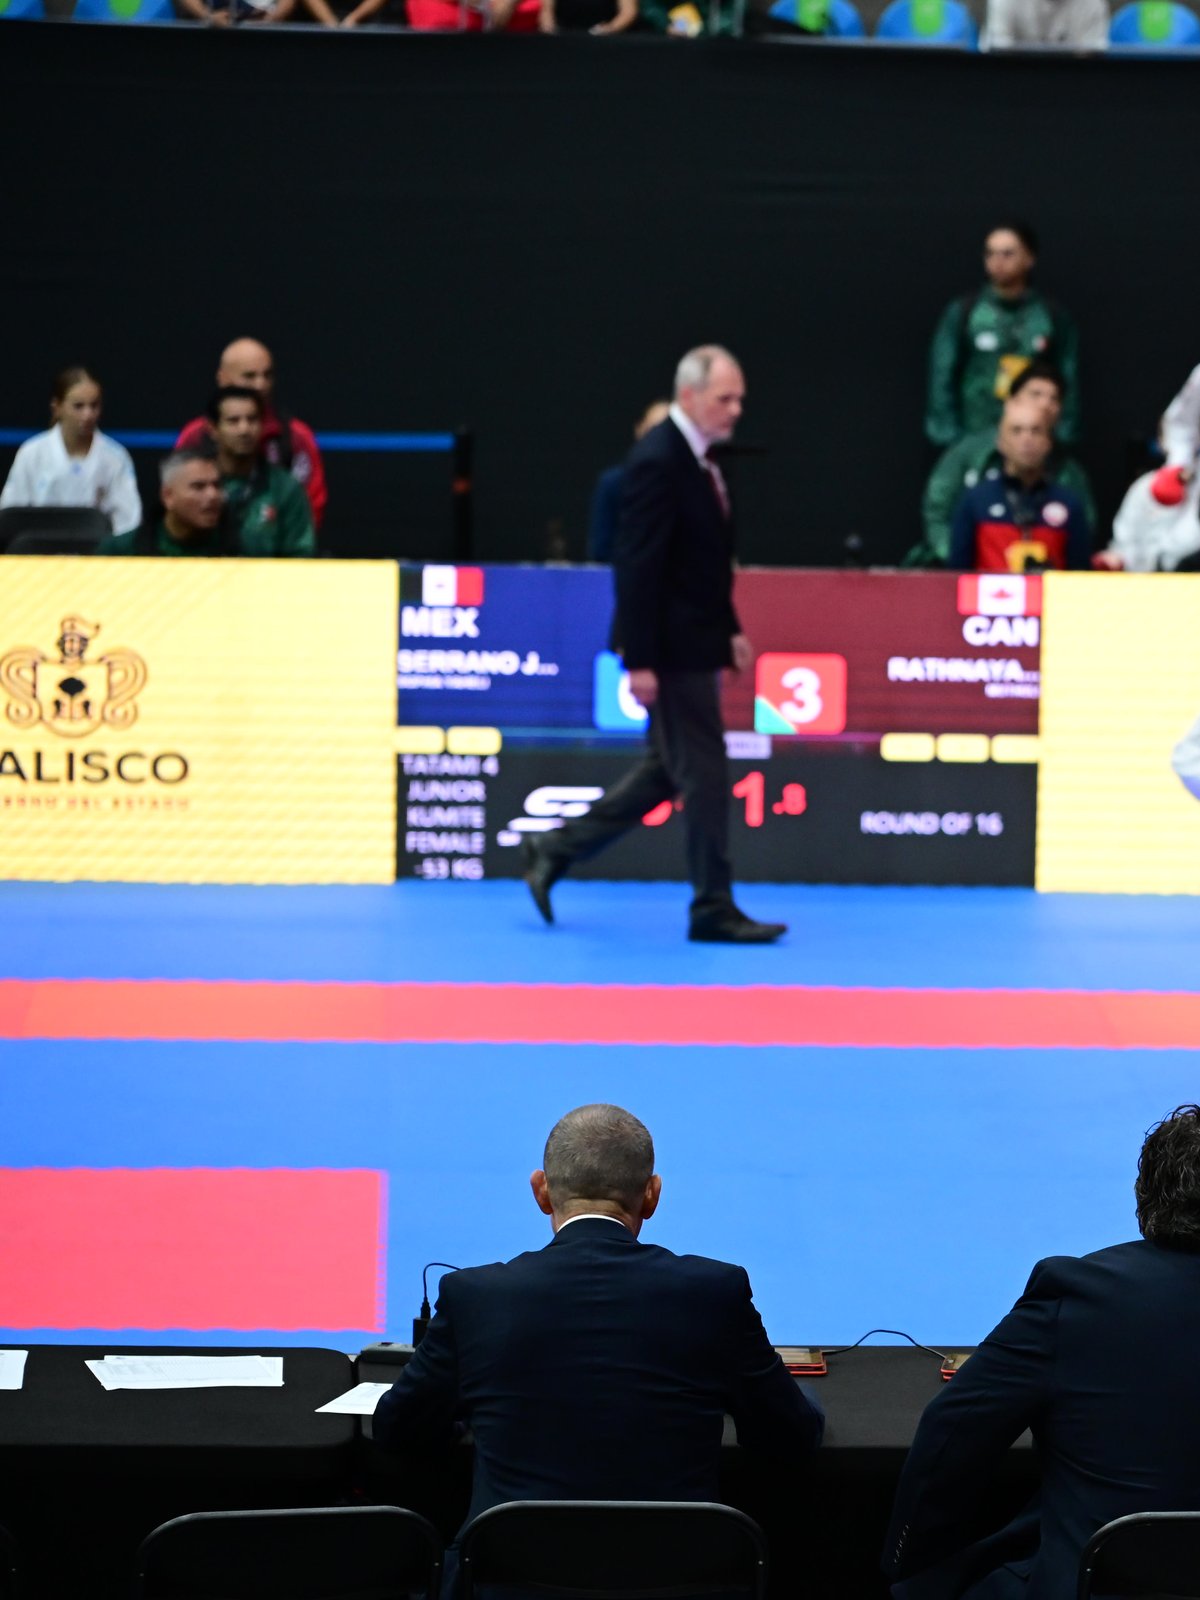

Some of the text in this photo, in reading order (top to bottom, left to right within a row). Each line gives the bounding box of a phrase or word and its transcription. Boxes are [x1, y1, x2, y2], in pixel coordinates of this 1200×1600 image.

[401, 606, 480, 637] MEX
[962, 616, 1040, 647] CAN
[778, 667, 824, 724] 3
[0, 750, 189, 784] ALISCO
[401, 754, 481, 776] TATAMI
[407, 780, 487, 802] JUNIOR
[406, 805, 486, 829] KUMITE
[860, 811, 1003, 837] ROUND OF 16
[405, 831, 486, 854] FEMALE
